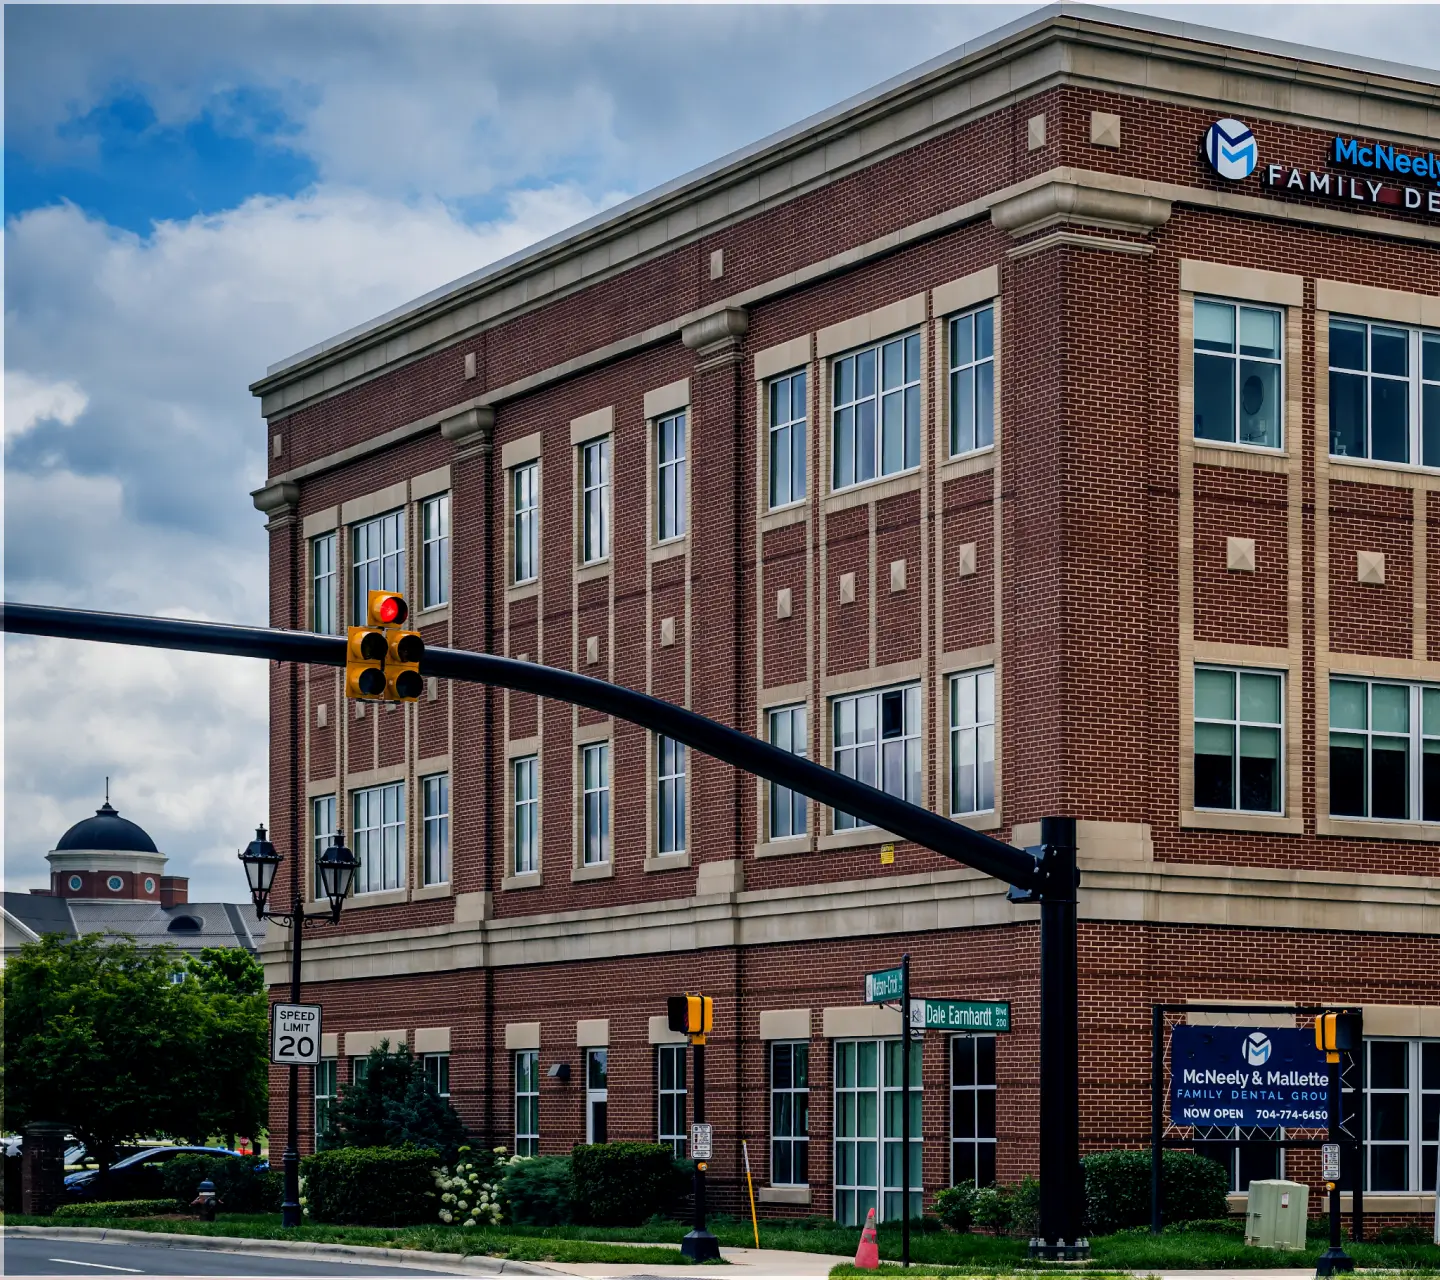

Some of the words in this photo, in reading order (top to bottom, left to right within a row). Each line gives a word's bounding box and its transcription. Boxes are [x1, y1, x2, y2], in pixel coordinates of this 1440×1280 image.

[1268, 165, 1383, 203] FAMILY
[280, 1010, 315, 1021] SPEED
[926, 1003, 946, 1024] Dale
[948, 1005, 992, 1027] Earnhardt
[995, 1006, 1007, 1016] Blvd
[283, 1022, 311, 1032] LIMIT
[995, 1018, 1007, 1027] 200
[279, 1035, 314, 1057] 20
[1183, 1068, 1249, 1089] McNeely
[1251, 1070, 1263, 1085] &
[1267, 1071, 1329, 1087] Mallette
[1177, 1089, 1224, 1099] FAMILY
[1231, 1090, 1284, 1100] DENTAL
[1291, 1091, 1328, 1101] GROU
[1183, 1108, 1211, 1119] NOW
[1213, 1108, 1244, 1119] OPEN
[1256, 1109, 1328, 1120] 704-774-6450
